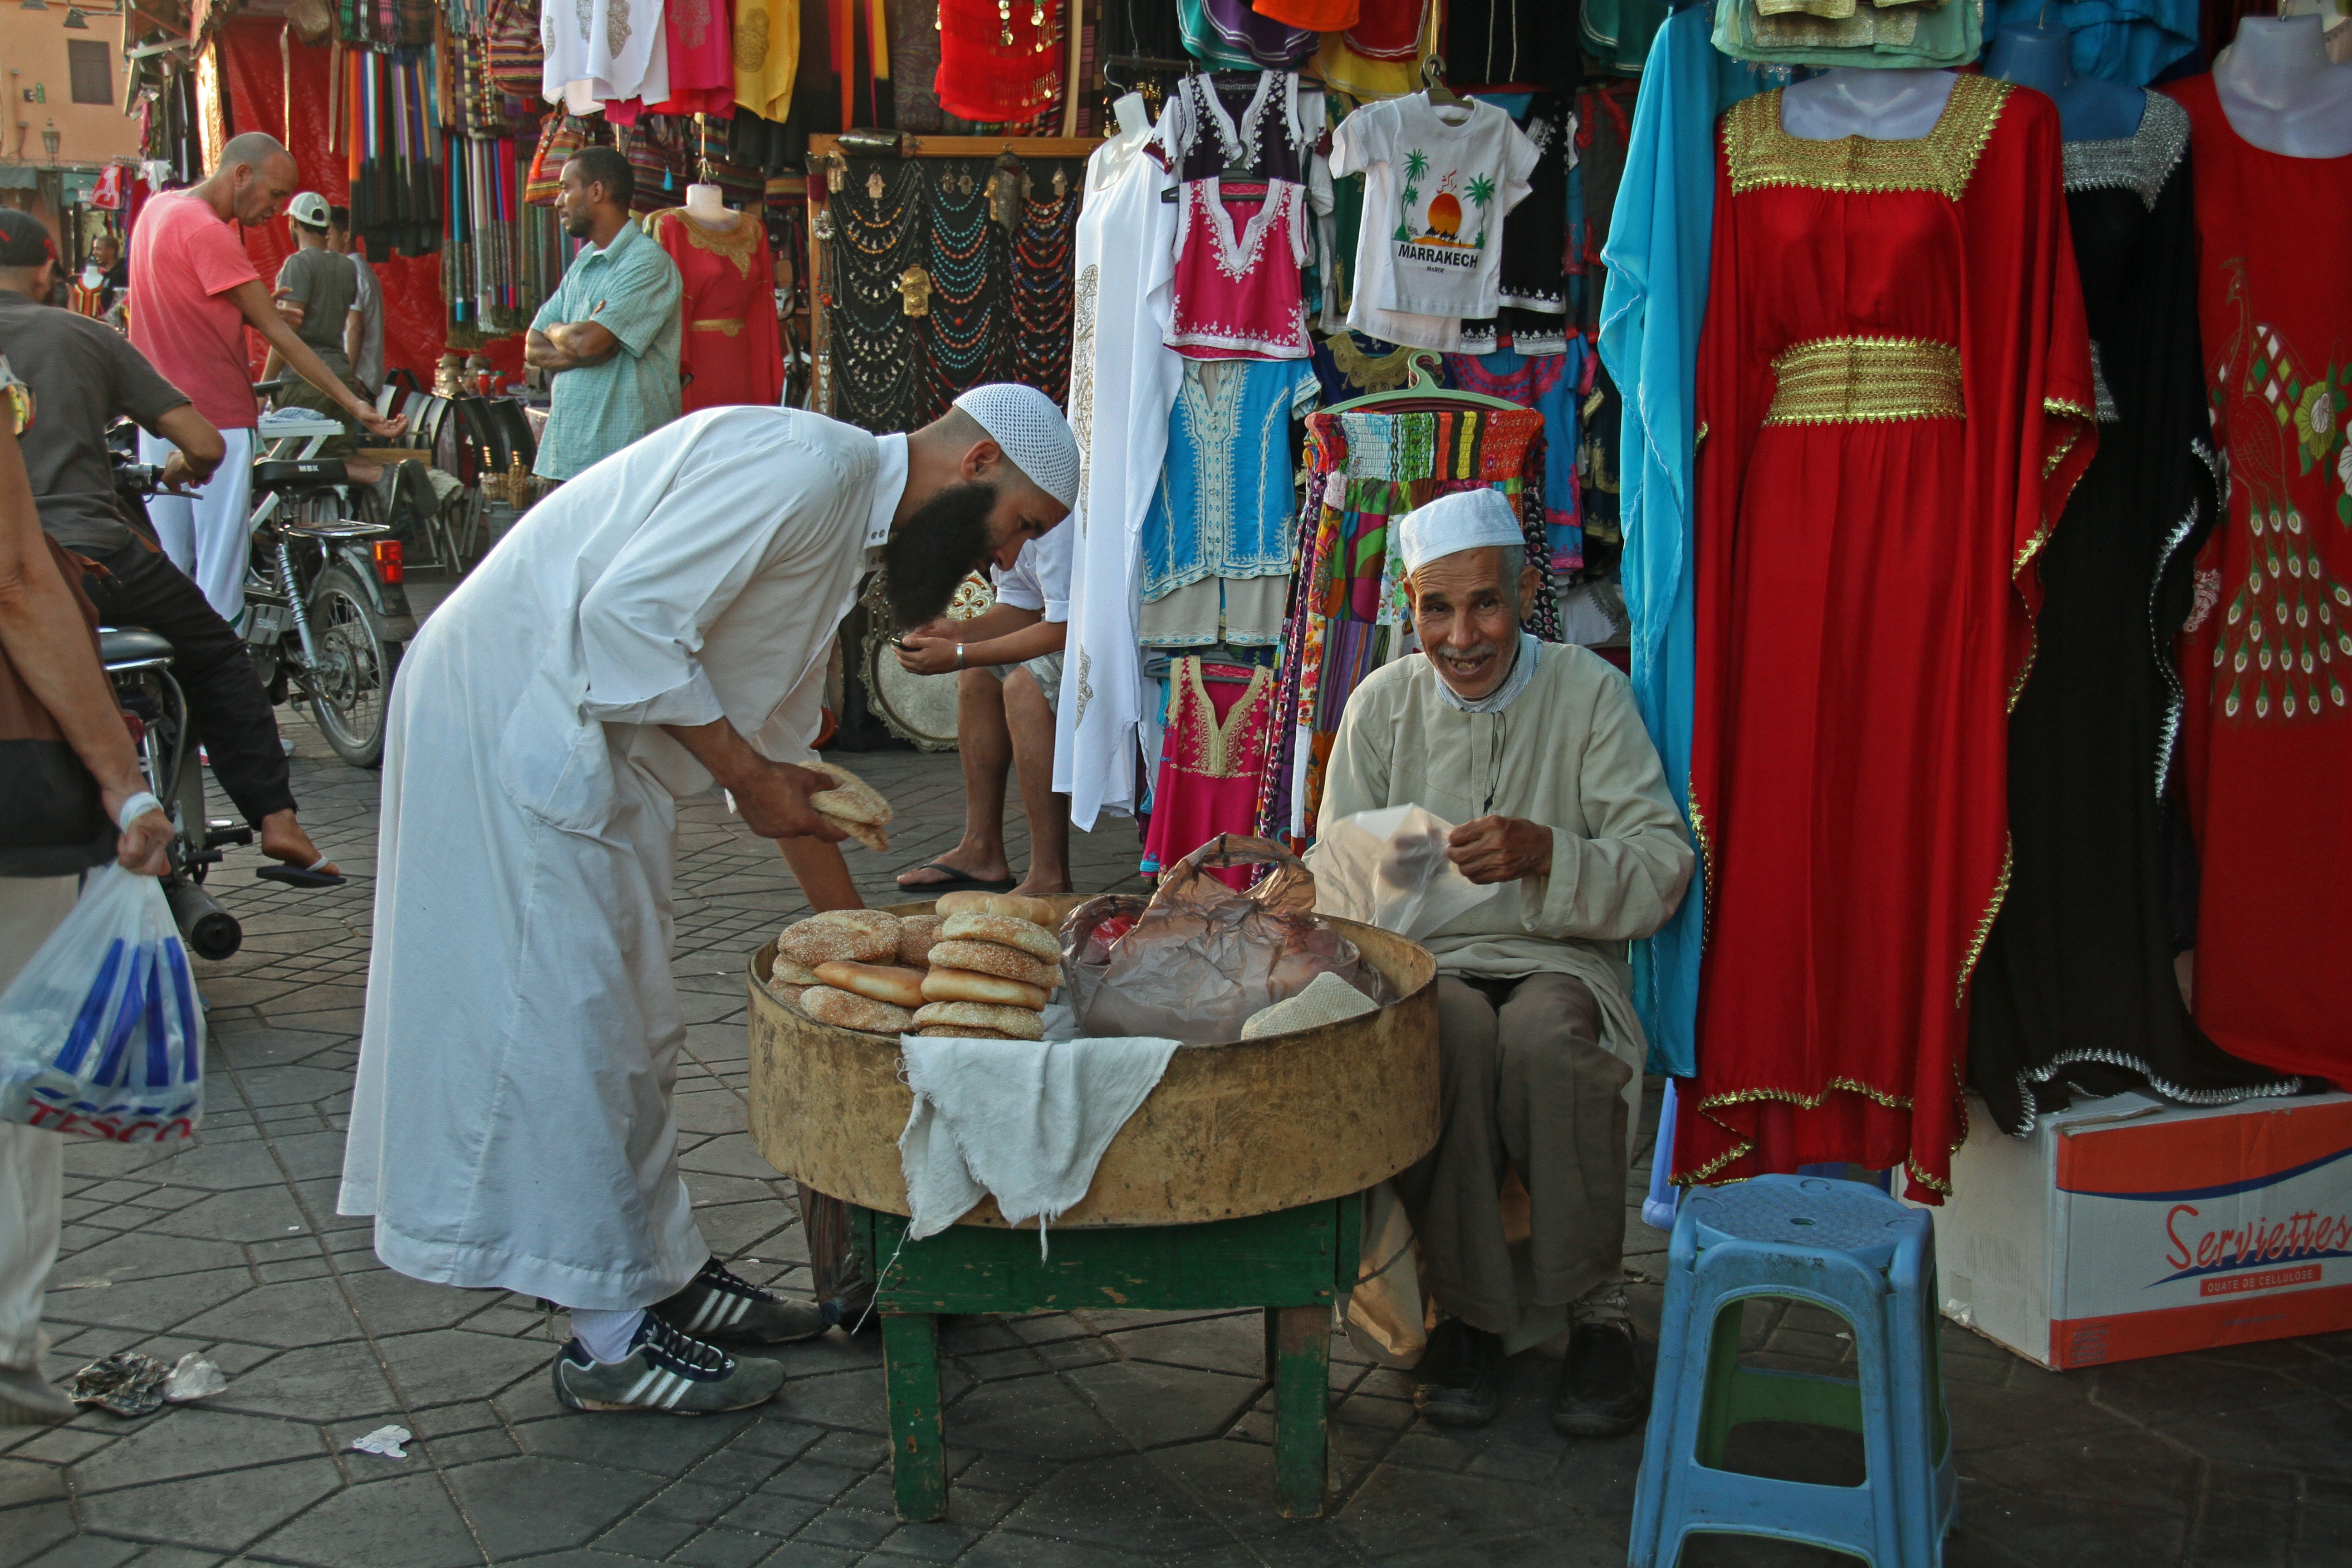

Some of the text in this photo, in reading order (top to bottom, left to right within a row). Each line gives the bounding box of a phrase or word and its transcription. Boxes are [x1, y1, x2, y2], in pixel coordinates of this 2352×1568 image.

[1436, 169, 1457, 194] مراكش
[1398, 244, 1478, 268] MARRAKECH
[2166, 1204, 2352, 1270] Serviettes
[2207, 1269, 2314, 1293] OUATE DE CELLULOSE
